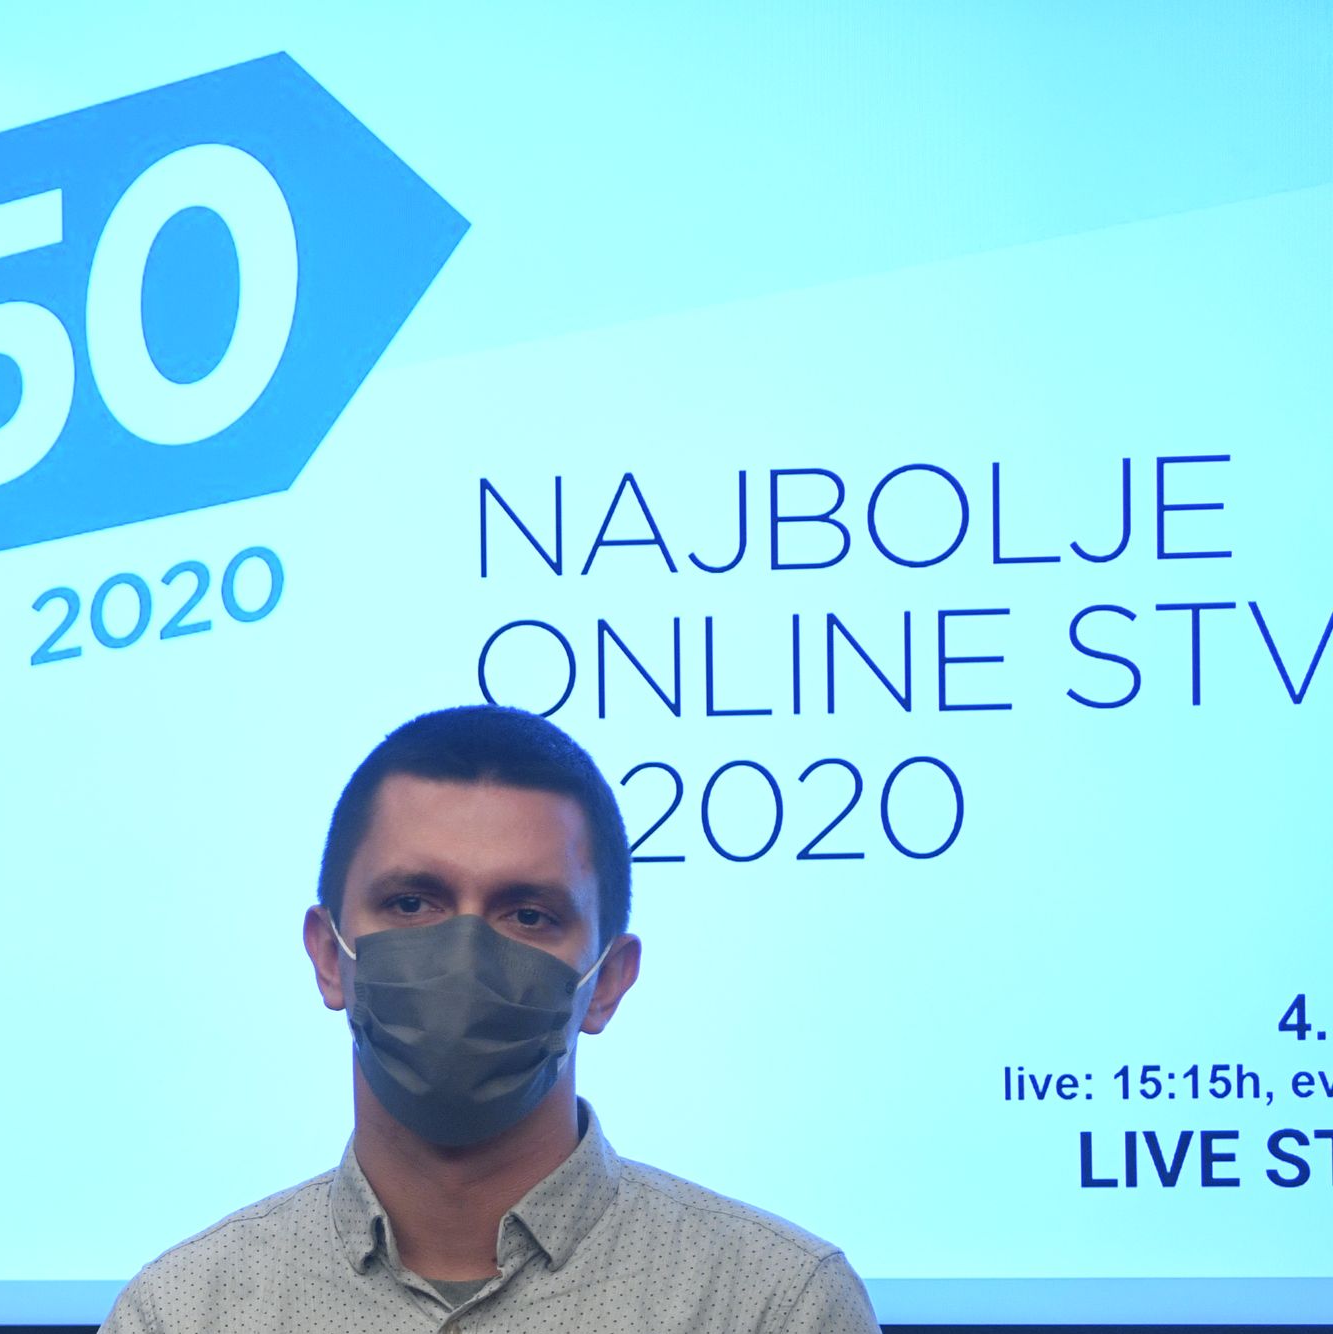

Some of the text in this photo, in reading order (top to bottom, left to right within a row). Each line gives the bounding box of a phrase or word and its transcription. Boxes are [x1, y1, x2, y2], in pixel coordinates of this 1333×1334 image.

[479, 454, 1233, 578] NAJBOLJE
[31, 546, 284, 666] 2020
[478, 608, 1013, 719] ONLINE
[619, 756, 964, 863] 2020
[1278, 993, 1326, 1041] 4.
[1004, 1066, 1093, 1101] live:
[1113, 1064, 1274, 1106] 15:15h,
[1080, 1130, 1240, 1188] LIVE
